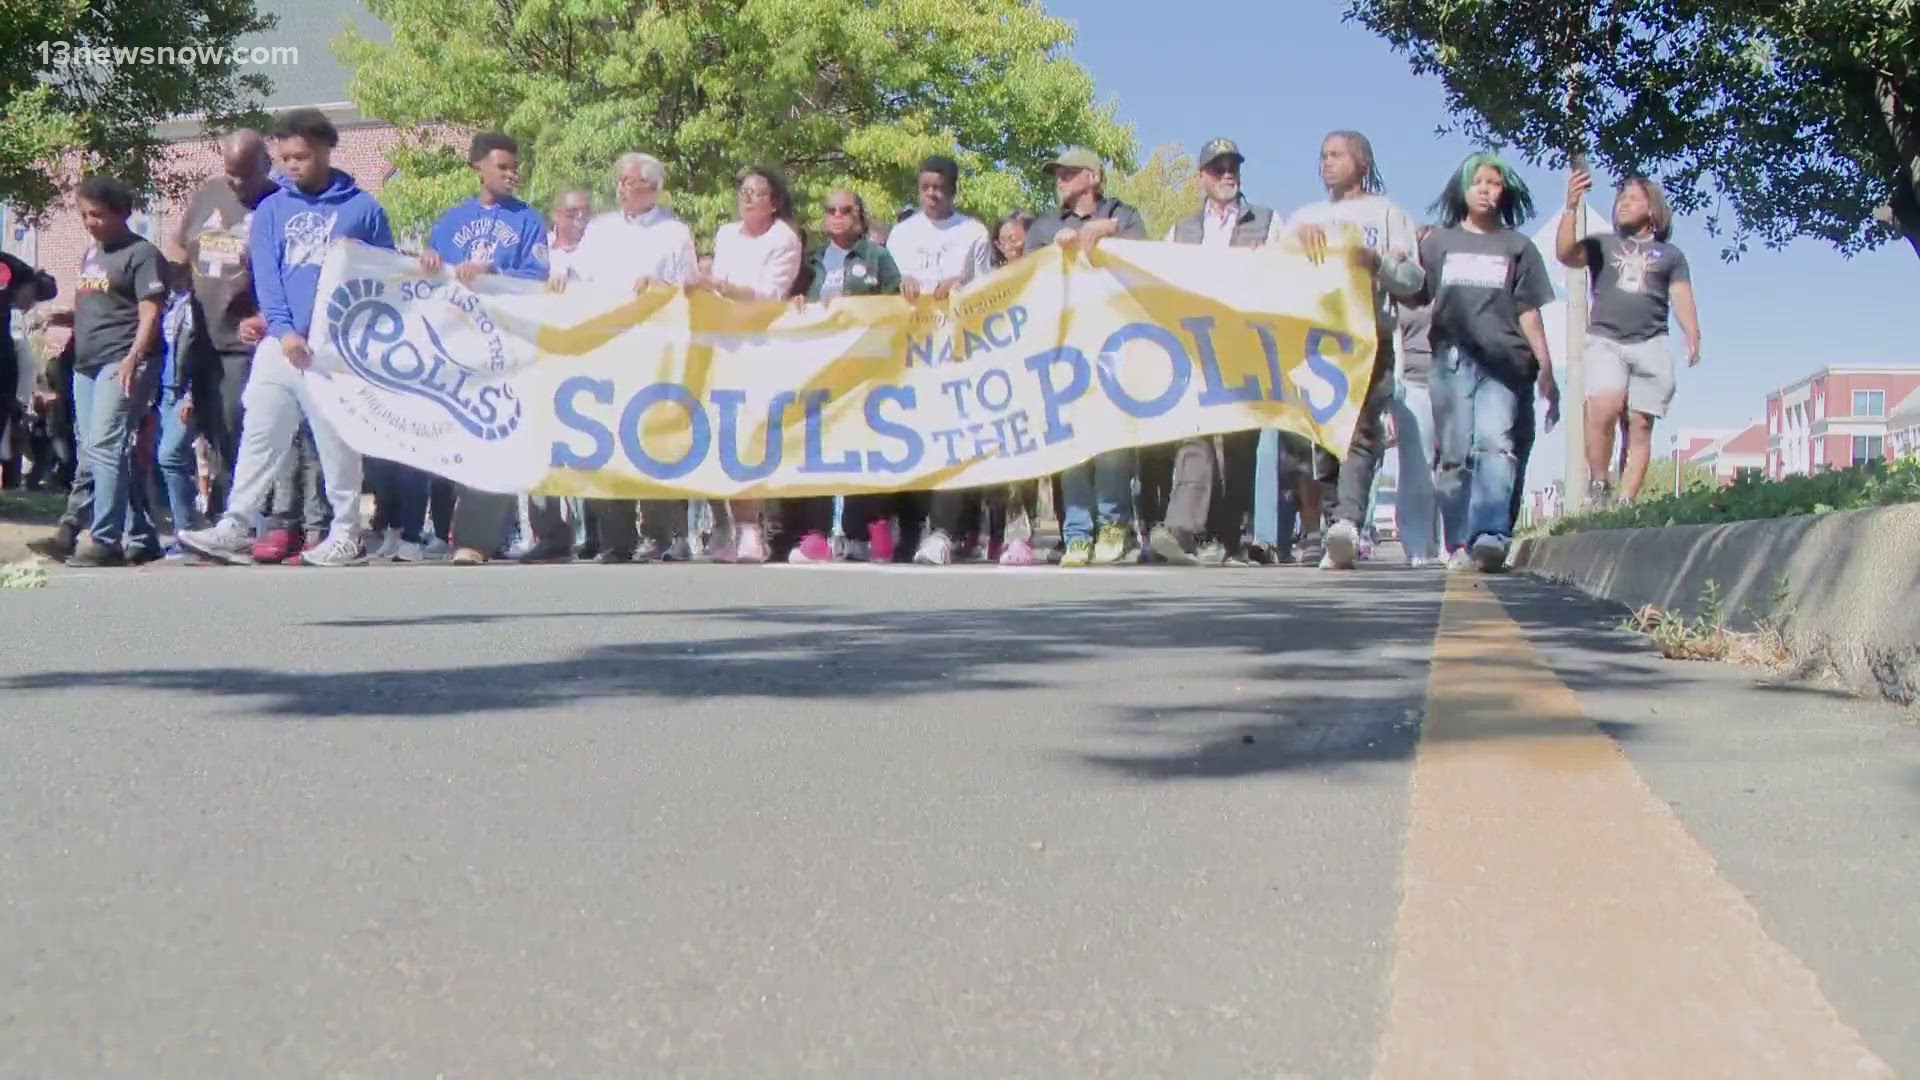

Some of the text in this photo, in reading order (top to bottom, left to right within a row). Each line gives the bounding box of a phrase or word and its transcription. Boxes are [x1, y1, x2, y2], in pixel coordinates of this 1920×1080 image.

[345, 300, 501, 425] POLLS
[401, 279, 504, 371] SOLS TO THE
[549, 375, 925, 482] SOULS
[931, 409, 1038, 466] THE
[941, 368, 1013, 419] TO
